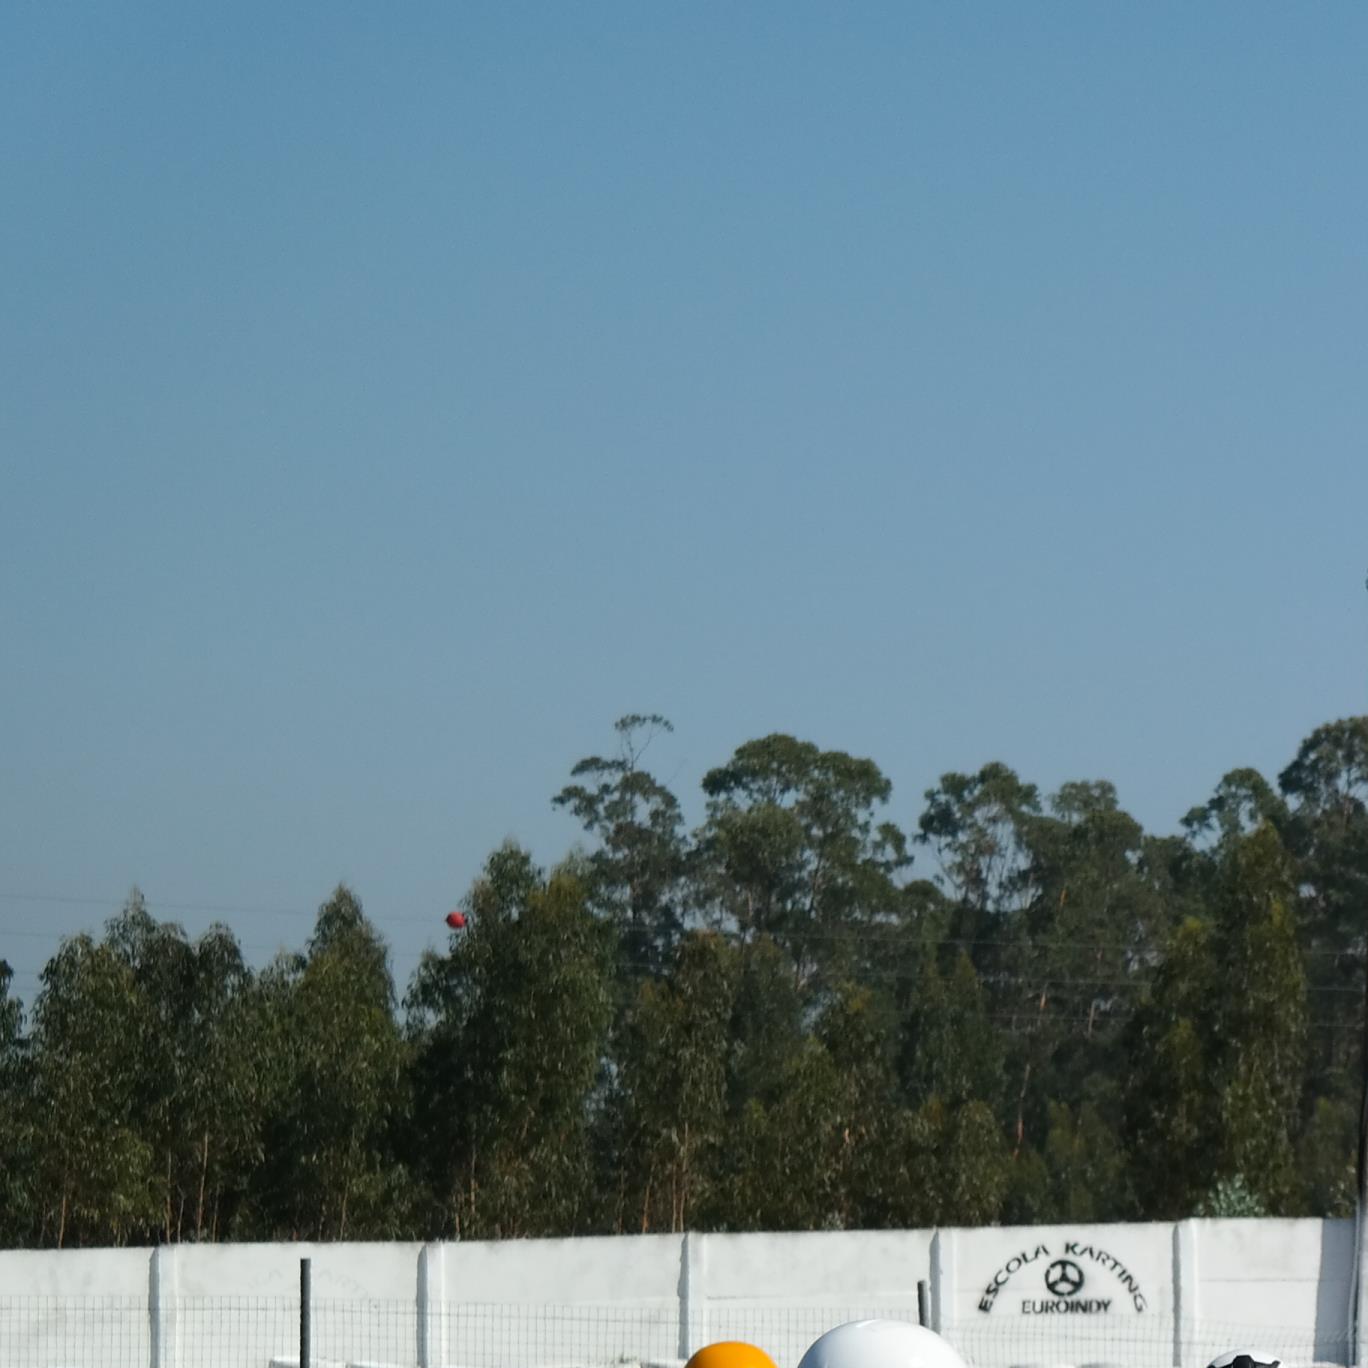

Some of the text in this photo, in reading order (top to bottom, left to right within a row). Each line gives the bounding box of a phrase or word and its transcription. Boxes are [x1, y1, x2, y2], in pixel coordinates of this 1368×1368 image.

[978, 1242, 1147, 1314] ESCOLA KARTING
[1022, 1299, 1113, 1314] EUROINDY
